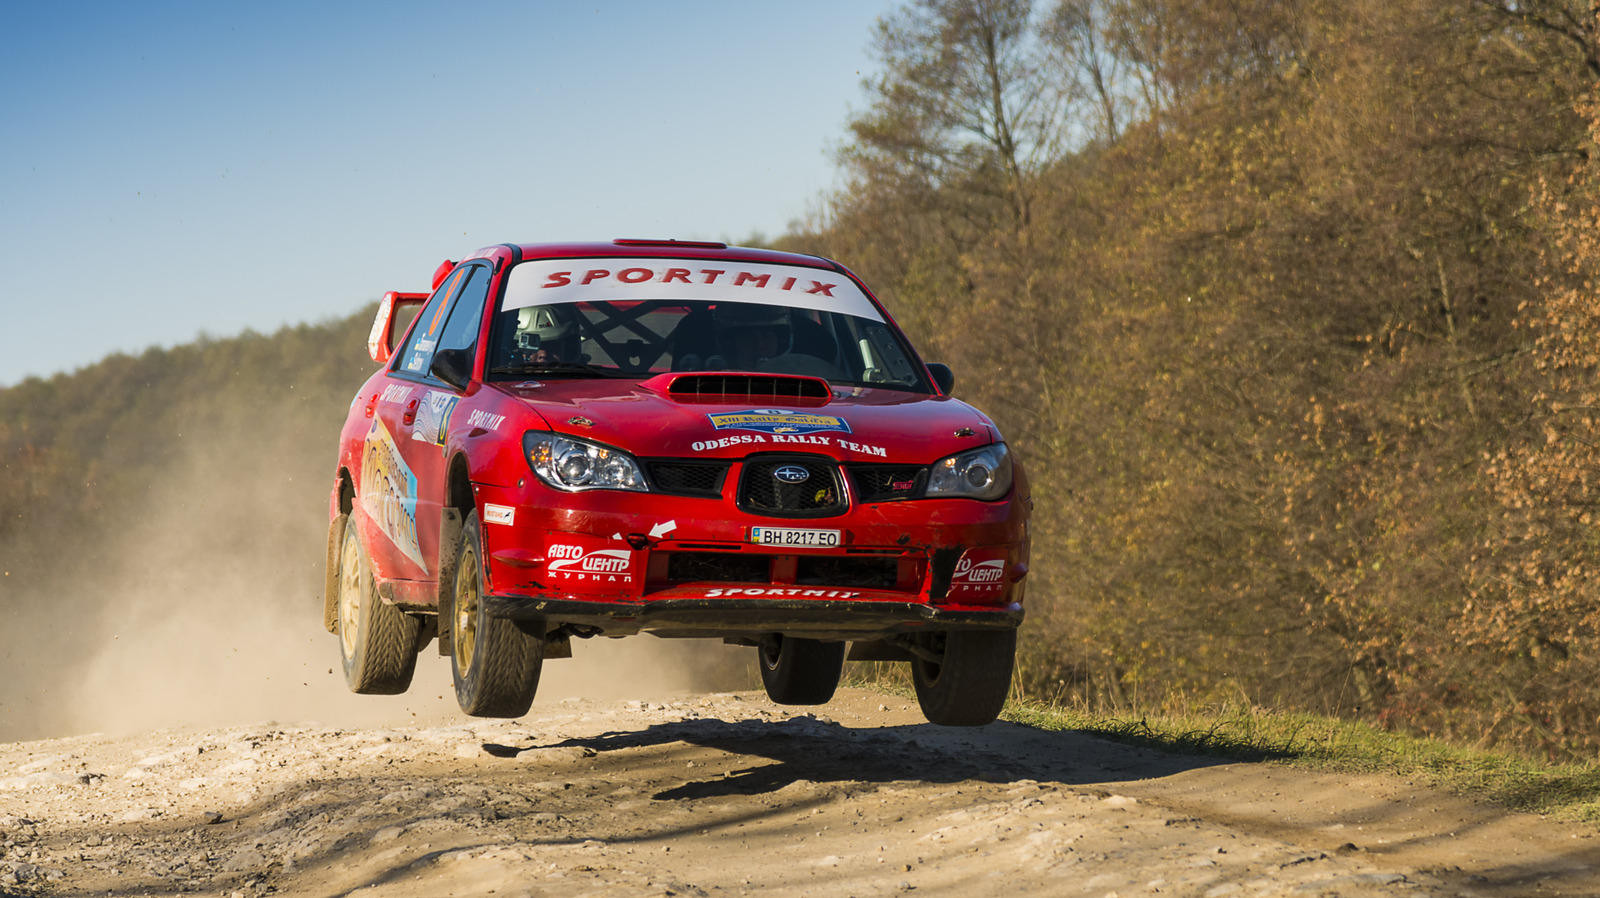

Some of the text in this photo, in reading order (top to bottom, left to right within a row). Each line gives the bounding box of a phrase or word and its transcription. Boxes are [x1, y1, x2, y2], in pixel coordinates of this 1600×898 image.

[541, 267, 838, 298] SPORTMIX
[429, 268, 465, 336] 8
[439, 401, 455, 441] 8
[467, 408, 506, 431] SPORTMIX
[691, 434, 888, 458] ODESSA RALLY TEAM
[764, 530, 837, 546] BH 8217 EO
[548, 544, 583, 559] АВТО
[582, 557, 630, 572] ЦЕНТР
[955, 558, 972, 571] ТО
[548, 571, 632, 583] ЖУРНАЛ
[968, 568, 1004, 582] ЦЕНТР
